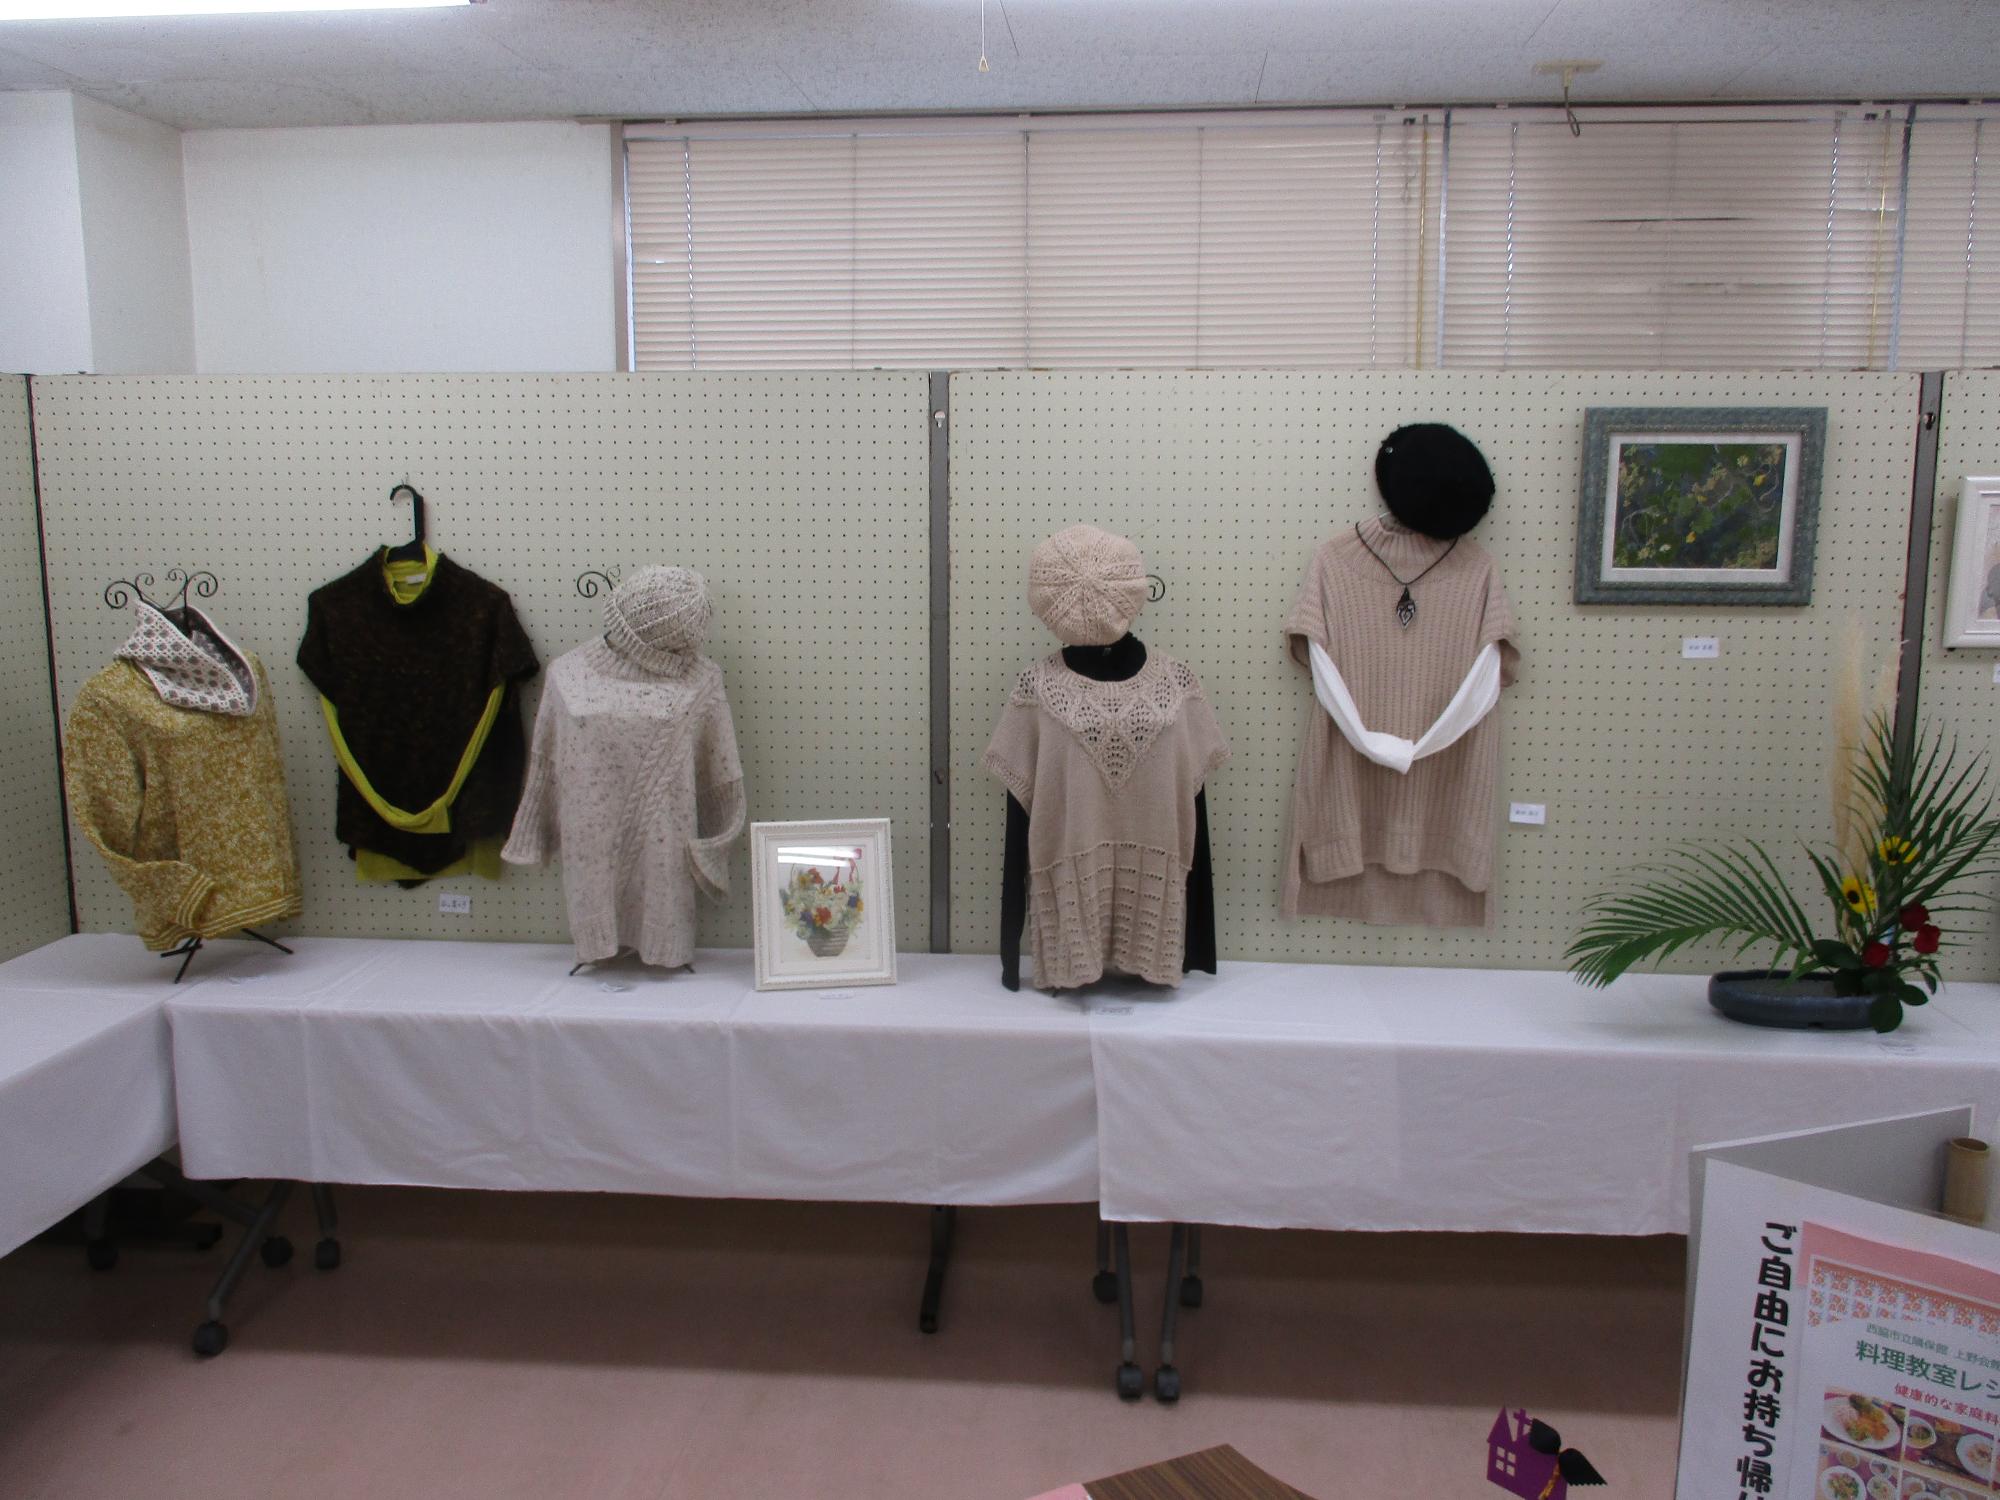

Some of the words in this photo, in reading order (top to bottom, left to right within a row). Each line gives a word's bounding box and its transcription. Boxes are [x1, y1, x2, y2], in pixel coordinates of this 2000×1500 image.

[1736, 1222, 1797, 1500] ご自由にお持ち帰
